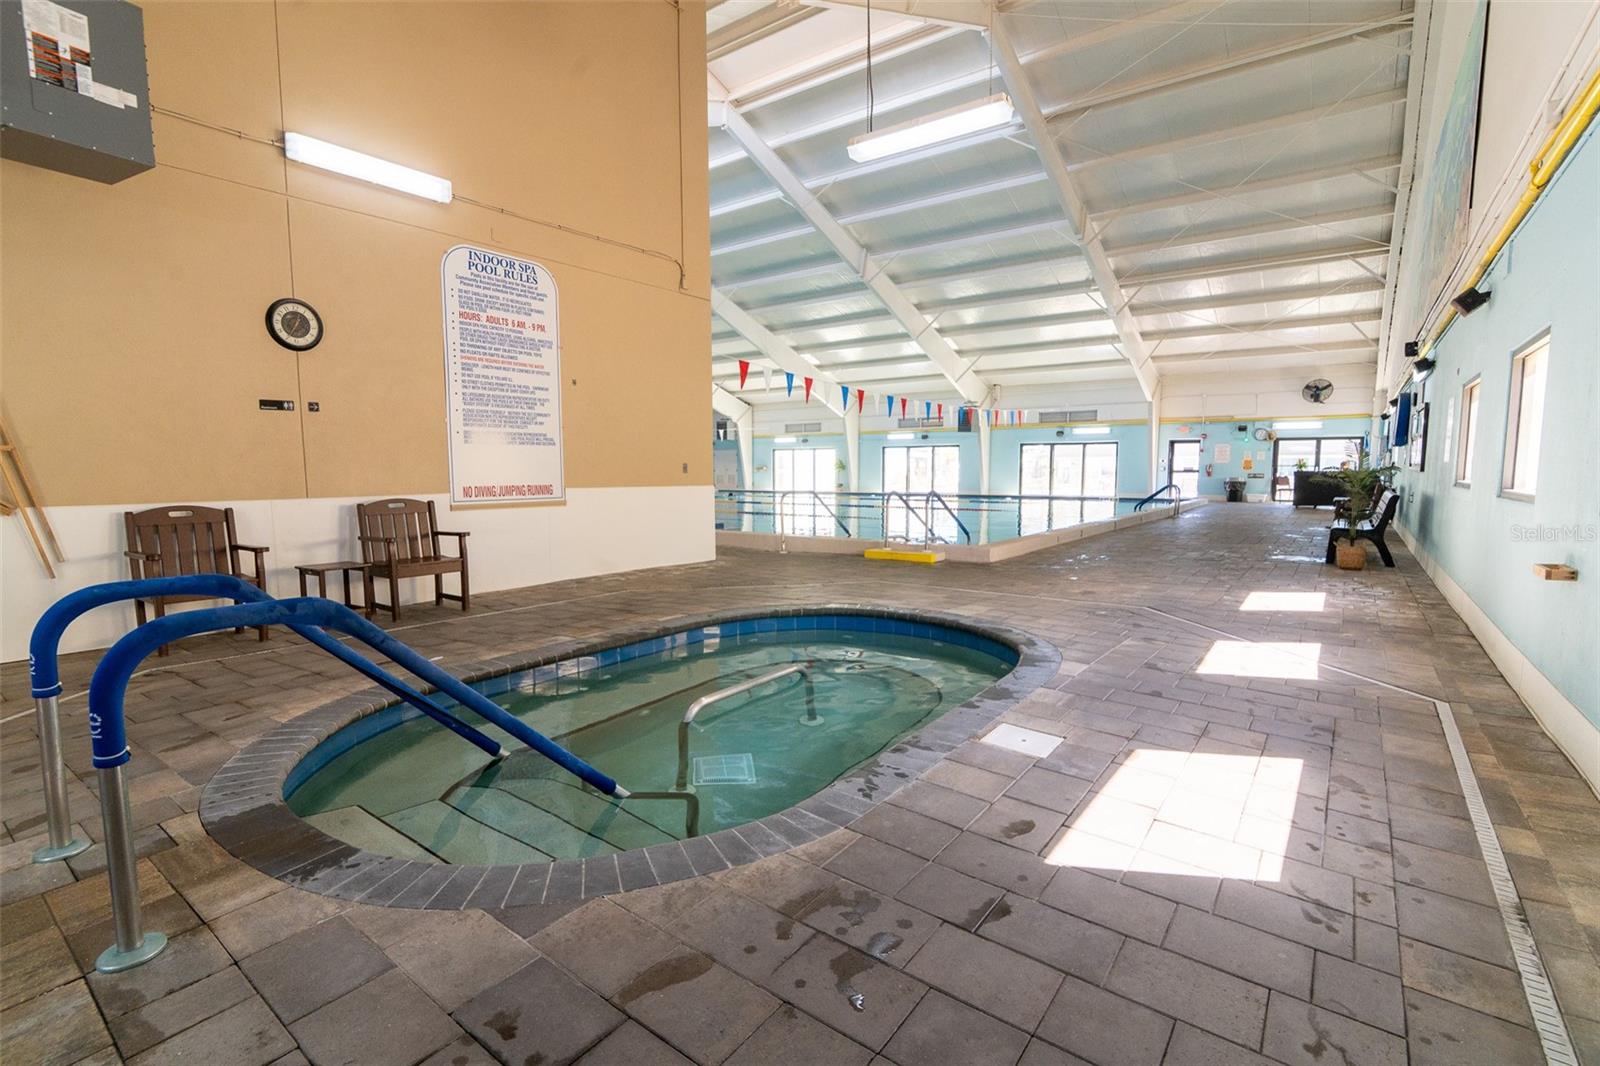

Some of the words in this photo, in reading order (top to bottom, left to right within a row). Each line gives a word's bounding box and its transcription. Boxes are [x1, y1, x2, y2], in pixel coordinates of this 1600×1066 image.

[468, 261, 501, 277] POOL
[504, 269, 538, 285] RULES
[469, 251, 516, 270] INDOOR
[519, 263, 536, 275] SPA
[485, 315, 509, 327] ADULTS
[512, 320, 516, 328] 6
[532, 323, 536, 331] 9
[463, 486, 473, 498] NO
[527, 483, 553, 495] RUNNING
